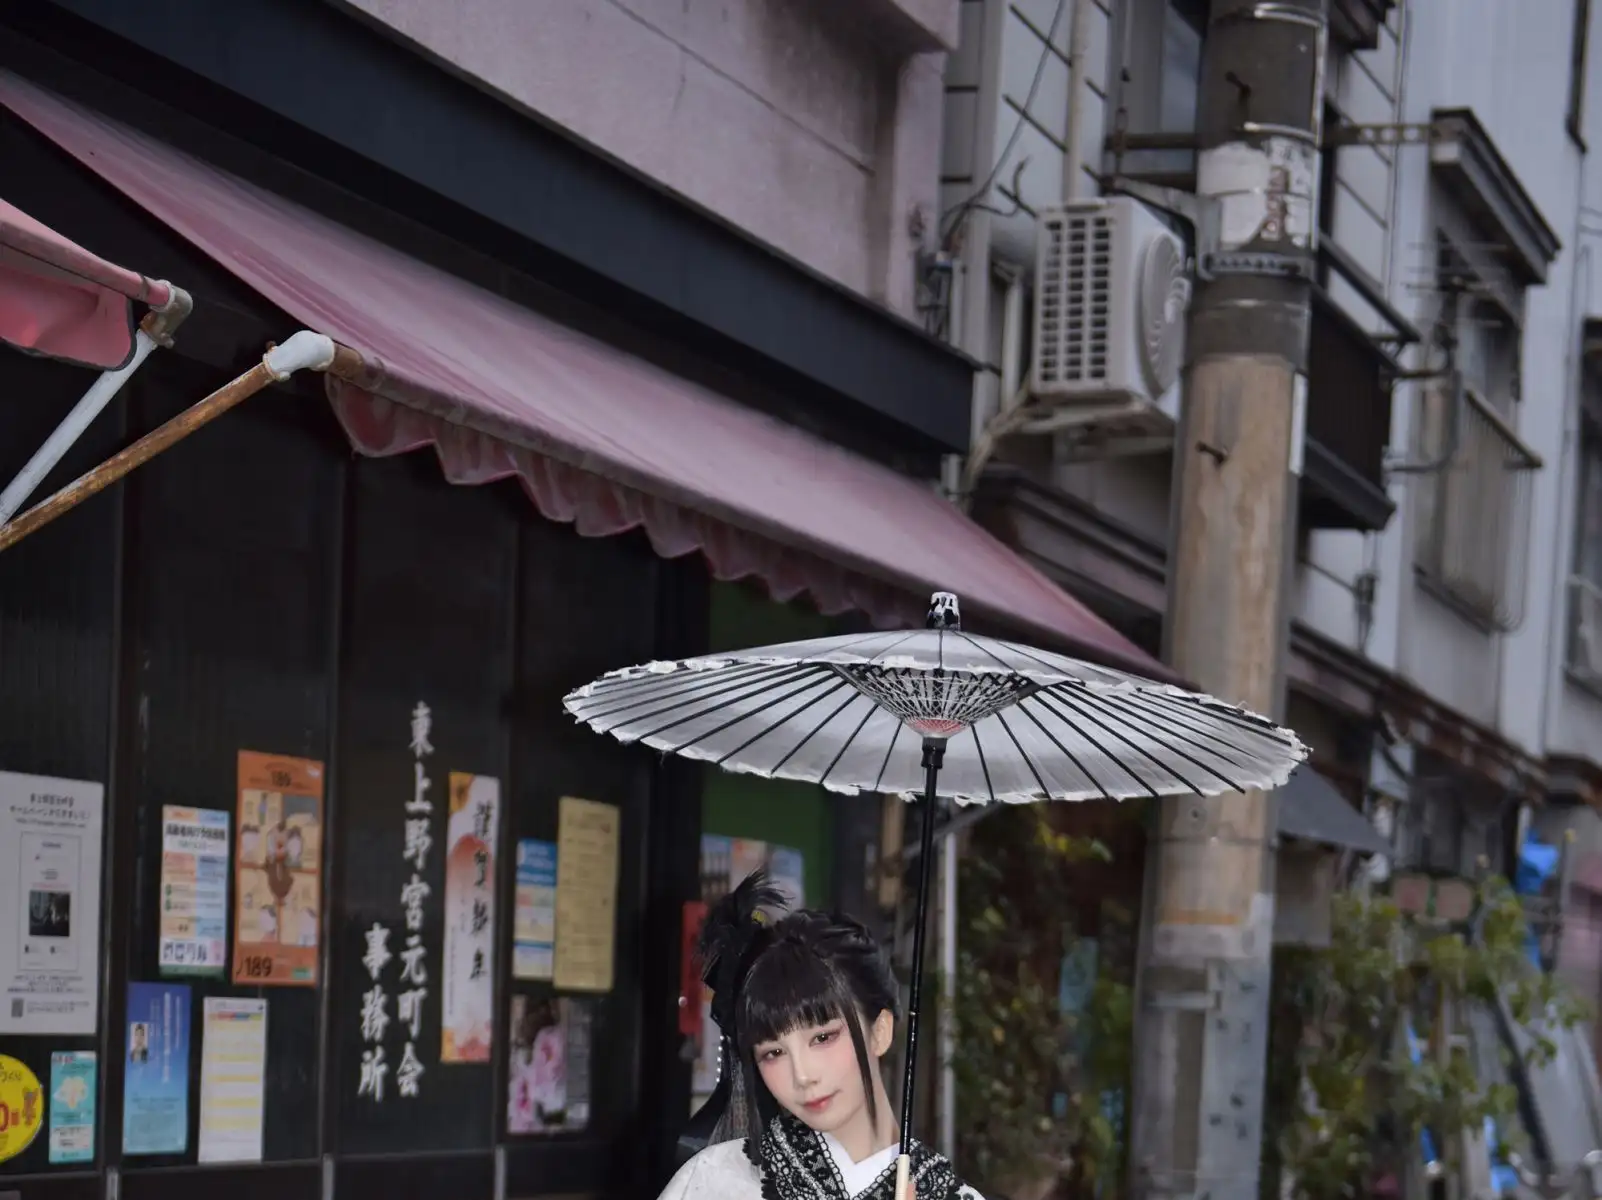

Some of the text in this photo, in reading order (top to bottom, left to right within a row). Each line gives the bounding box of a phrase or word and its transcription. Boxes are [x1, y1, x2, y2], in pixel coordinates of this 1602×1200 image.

[245, 955, 273, 977] 189
[396, 700, 435, 1098] 東上野宮元町会
[469, 799, 494, 982] 謹賀新年
[357, 921, 393, 1102] 事務所
